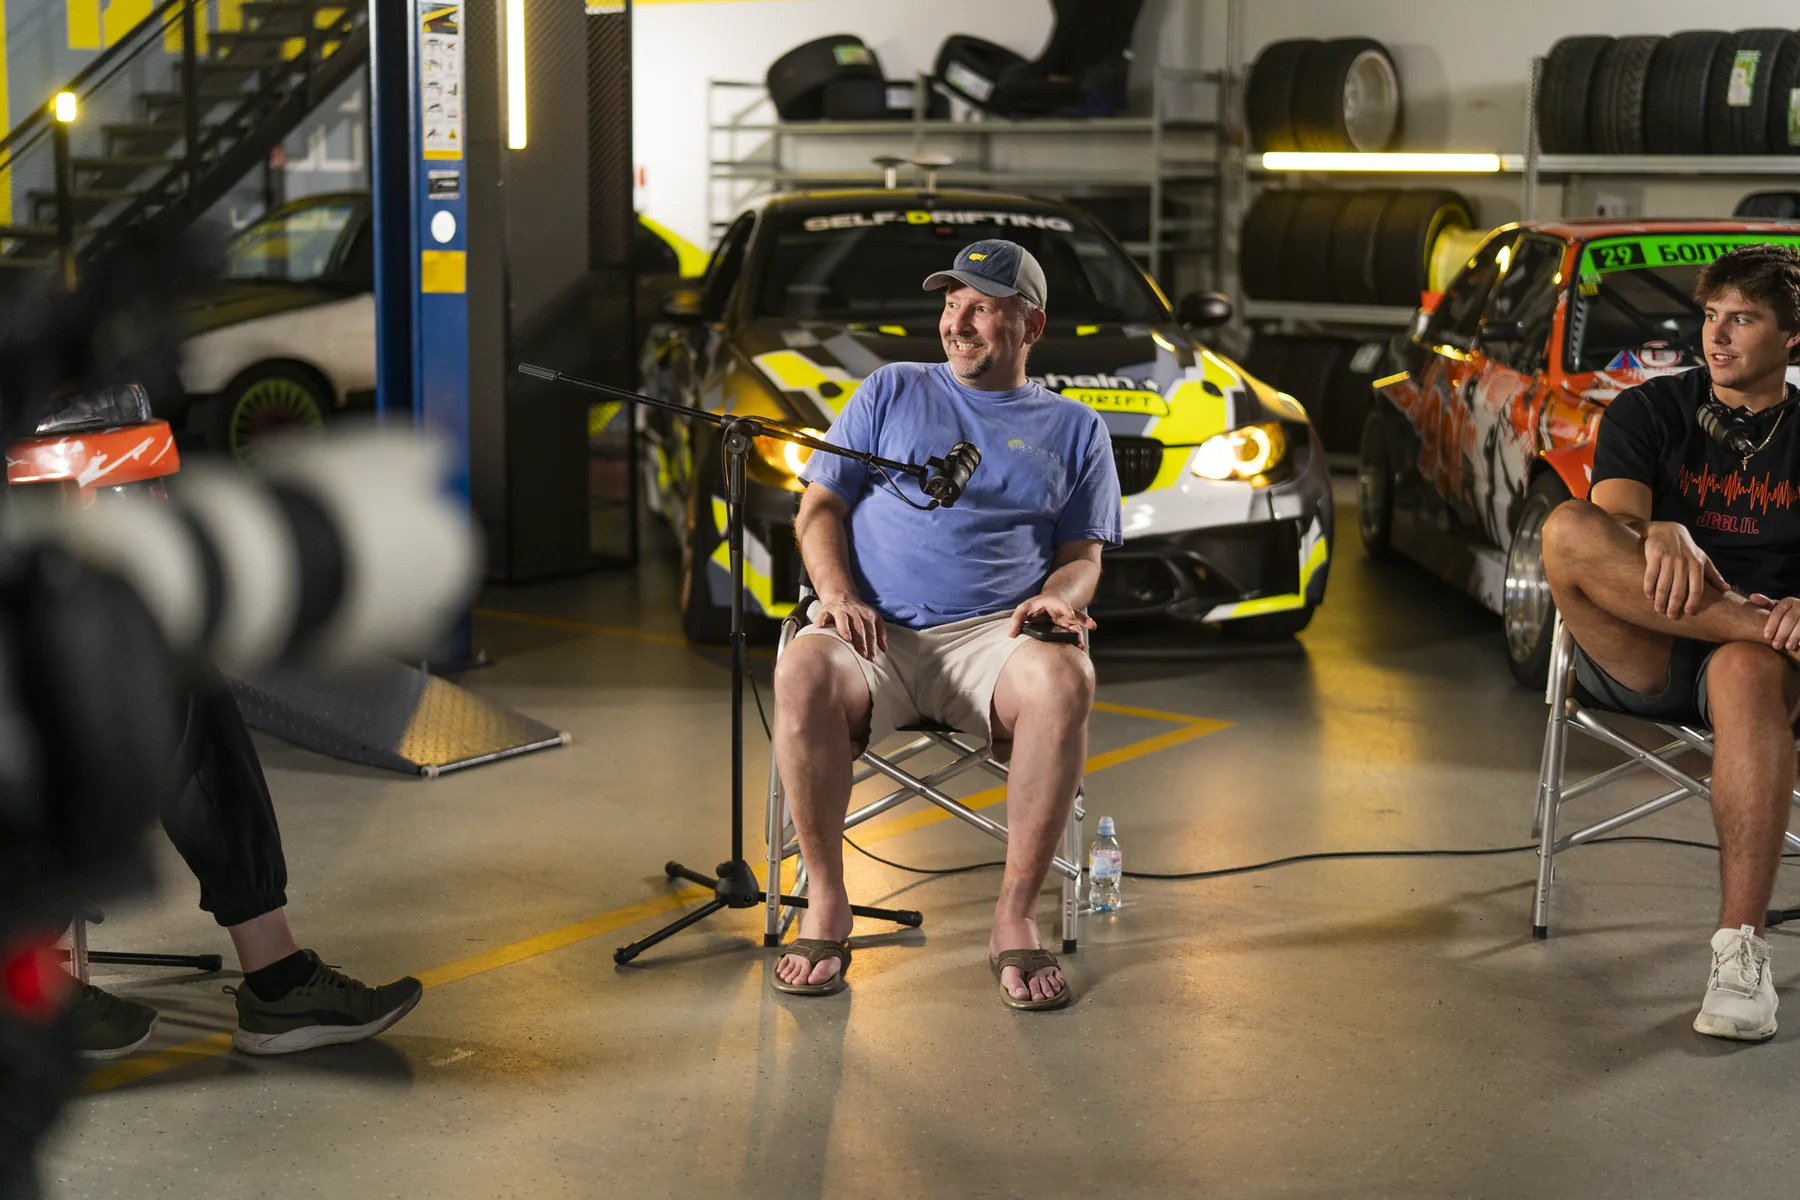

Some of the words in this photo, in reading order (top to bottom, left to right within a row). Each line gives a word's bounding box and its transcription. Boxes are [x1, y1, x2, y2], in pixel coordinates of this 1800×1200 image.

[803, 210, 1075, 232] SELF-DRIFTING
[1600, 246, 1633, 268] 29
[1079, 393, 1153, 407] DRIFT
